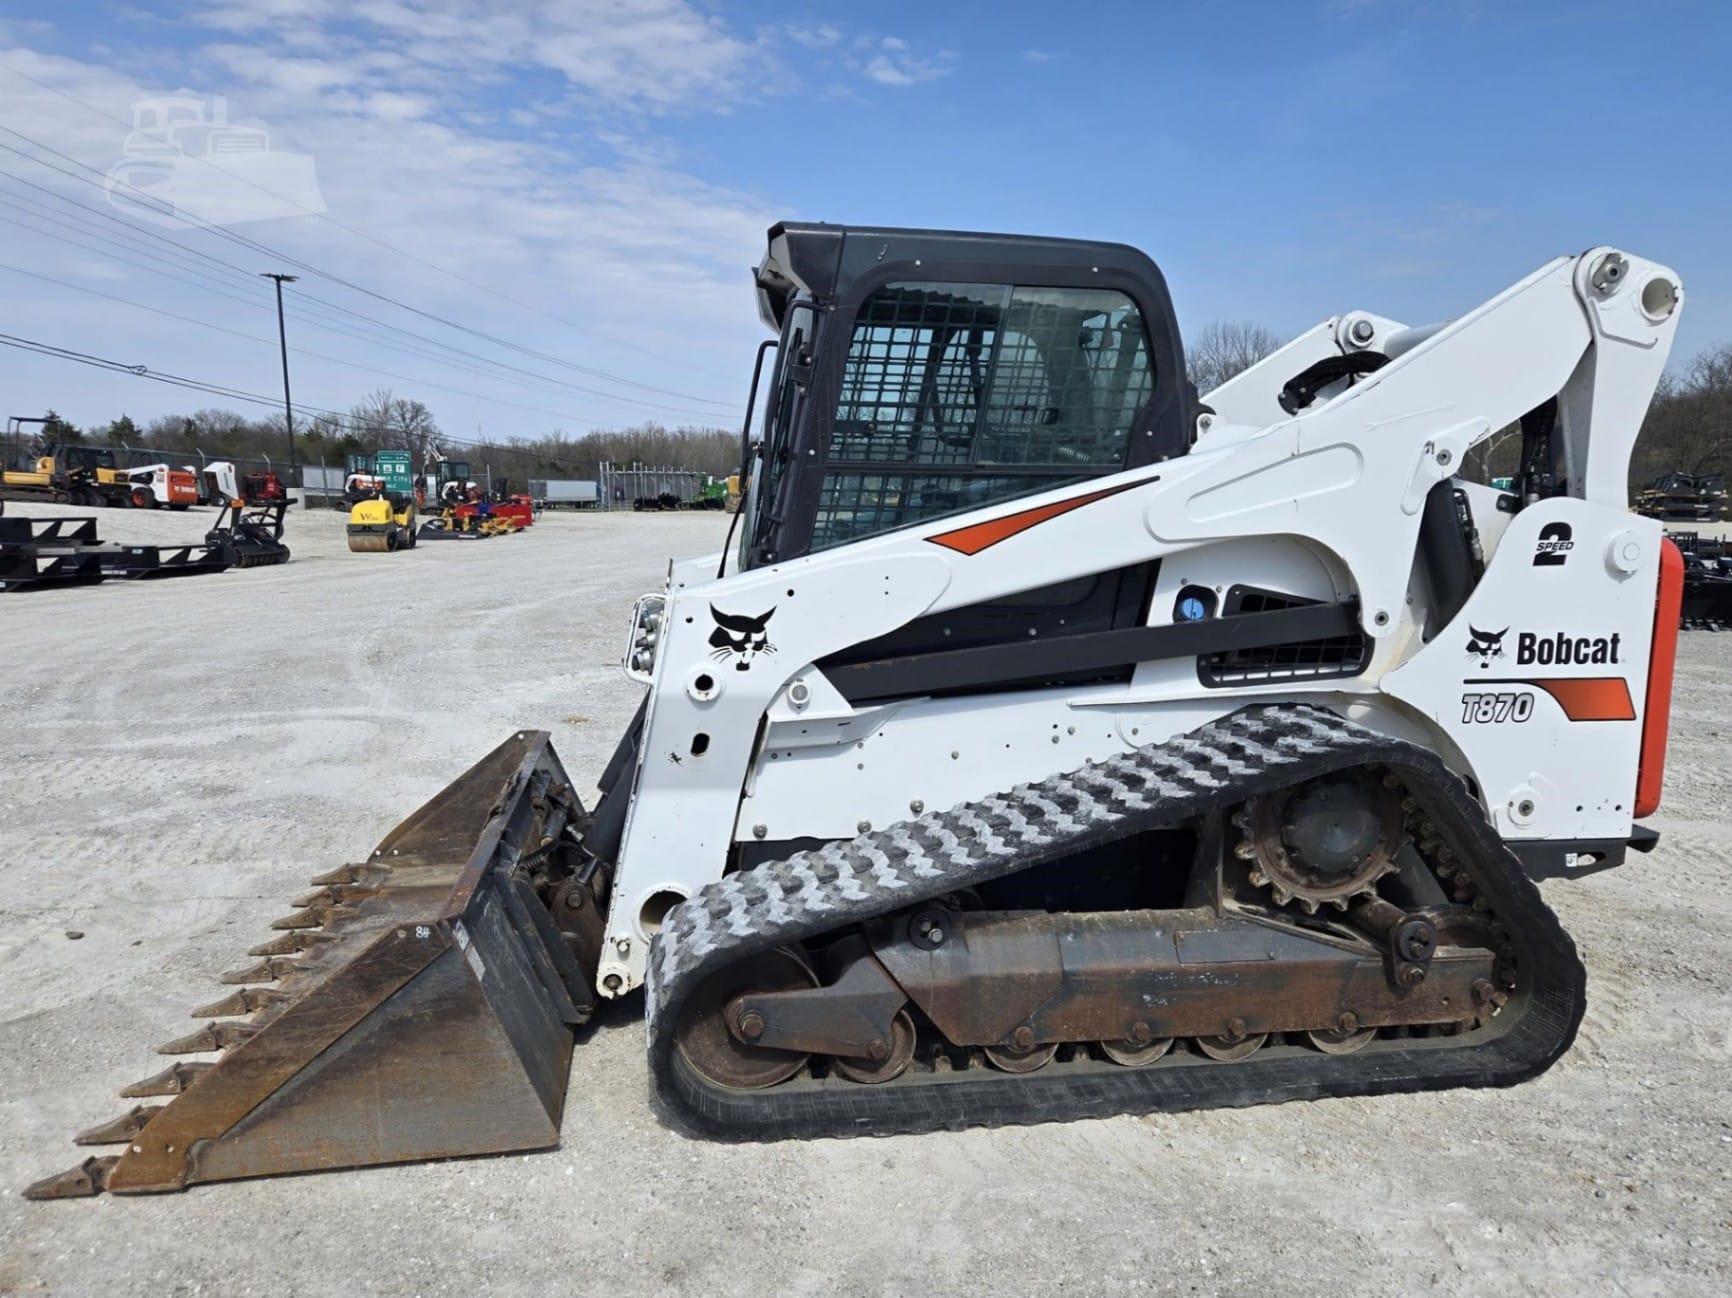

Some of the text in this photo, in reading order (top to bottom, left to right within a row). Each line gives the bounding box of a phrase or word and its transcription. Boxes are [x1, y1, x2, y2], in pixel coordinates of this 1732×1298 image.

[1532, 521, 1573, 567] 2
[1536, 540, 1575, 552] SPEED
[1517, 632, 1620, 665] Bobcat
[1462, 692, 1535, 724] T870
